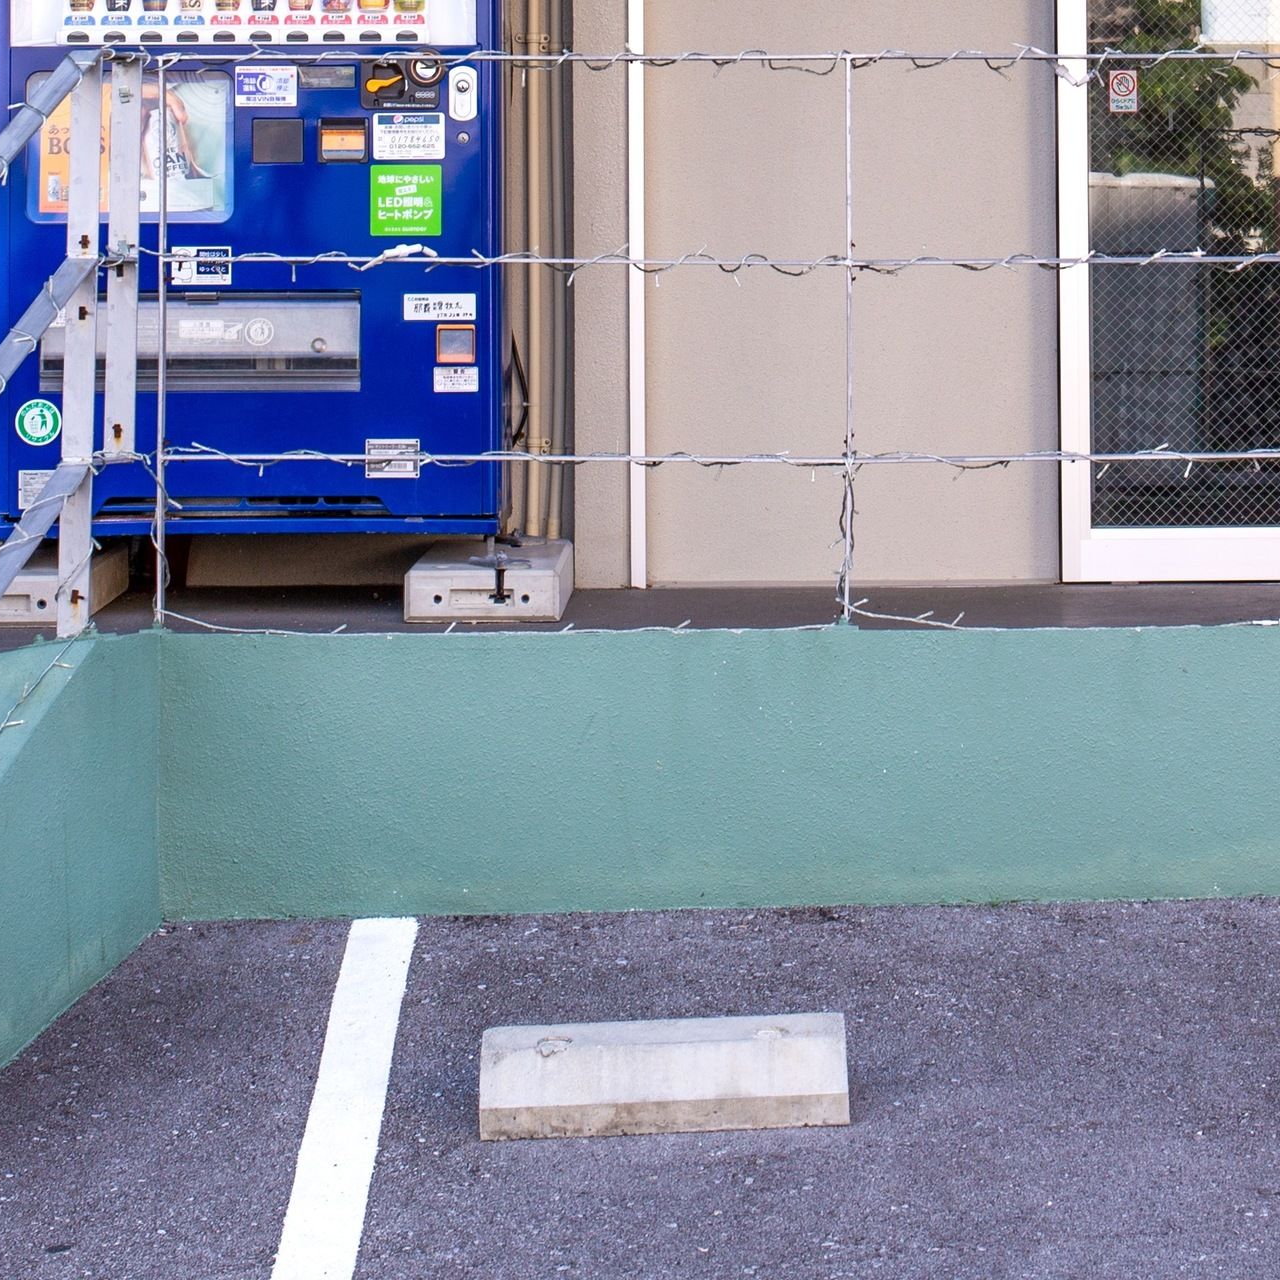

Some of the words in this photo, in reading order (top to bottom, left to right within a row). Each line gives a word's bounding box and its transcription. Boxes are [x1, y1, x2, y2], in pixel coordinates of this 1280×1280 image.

[378, 174, 435, 184] 地球にやさしい
[378, 208, 434, 221] ヒートポンプ
